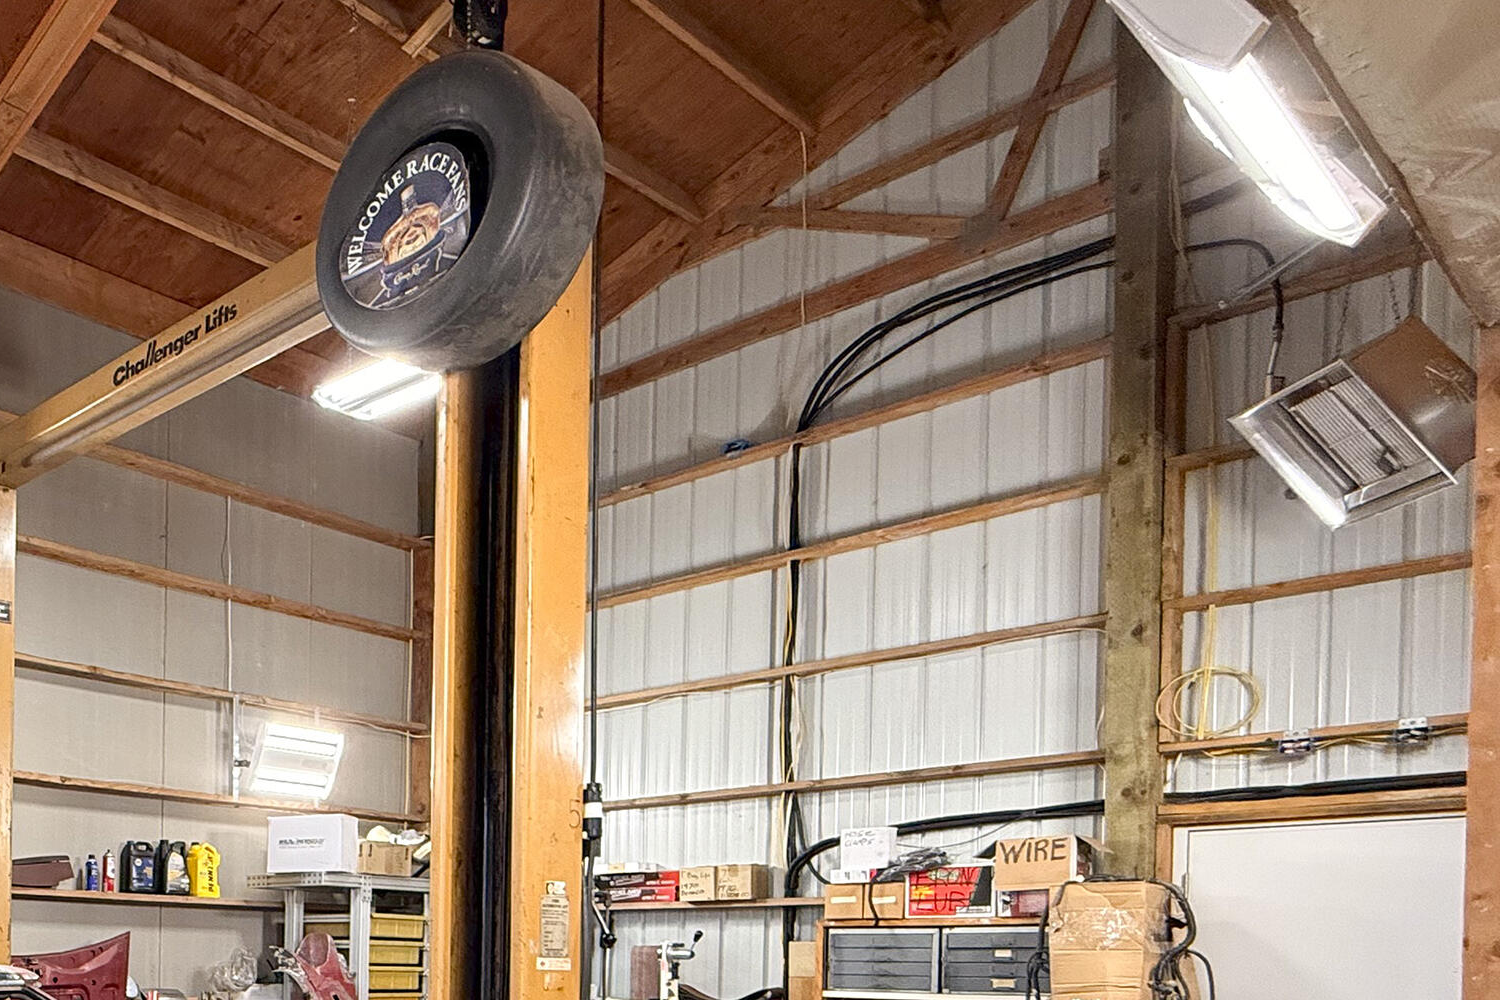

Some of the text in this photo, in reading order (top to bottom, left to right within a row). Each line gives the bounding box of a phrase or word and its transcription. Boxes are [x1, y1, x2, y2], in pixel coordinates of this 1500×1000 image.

[347, 152, 466, 275] WELCOME RACE FANS
[113, 303, 238, 387] Challenger Lifts
[999, 837, 1068, 865] WIRE
